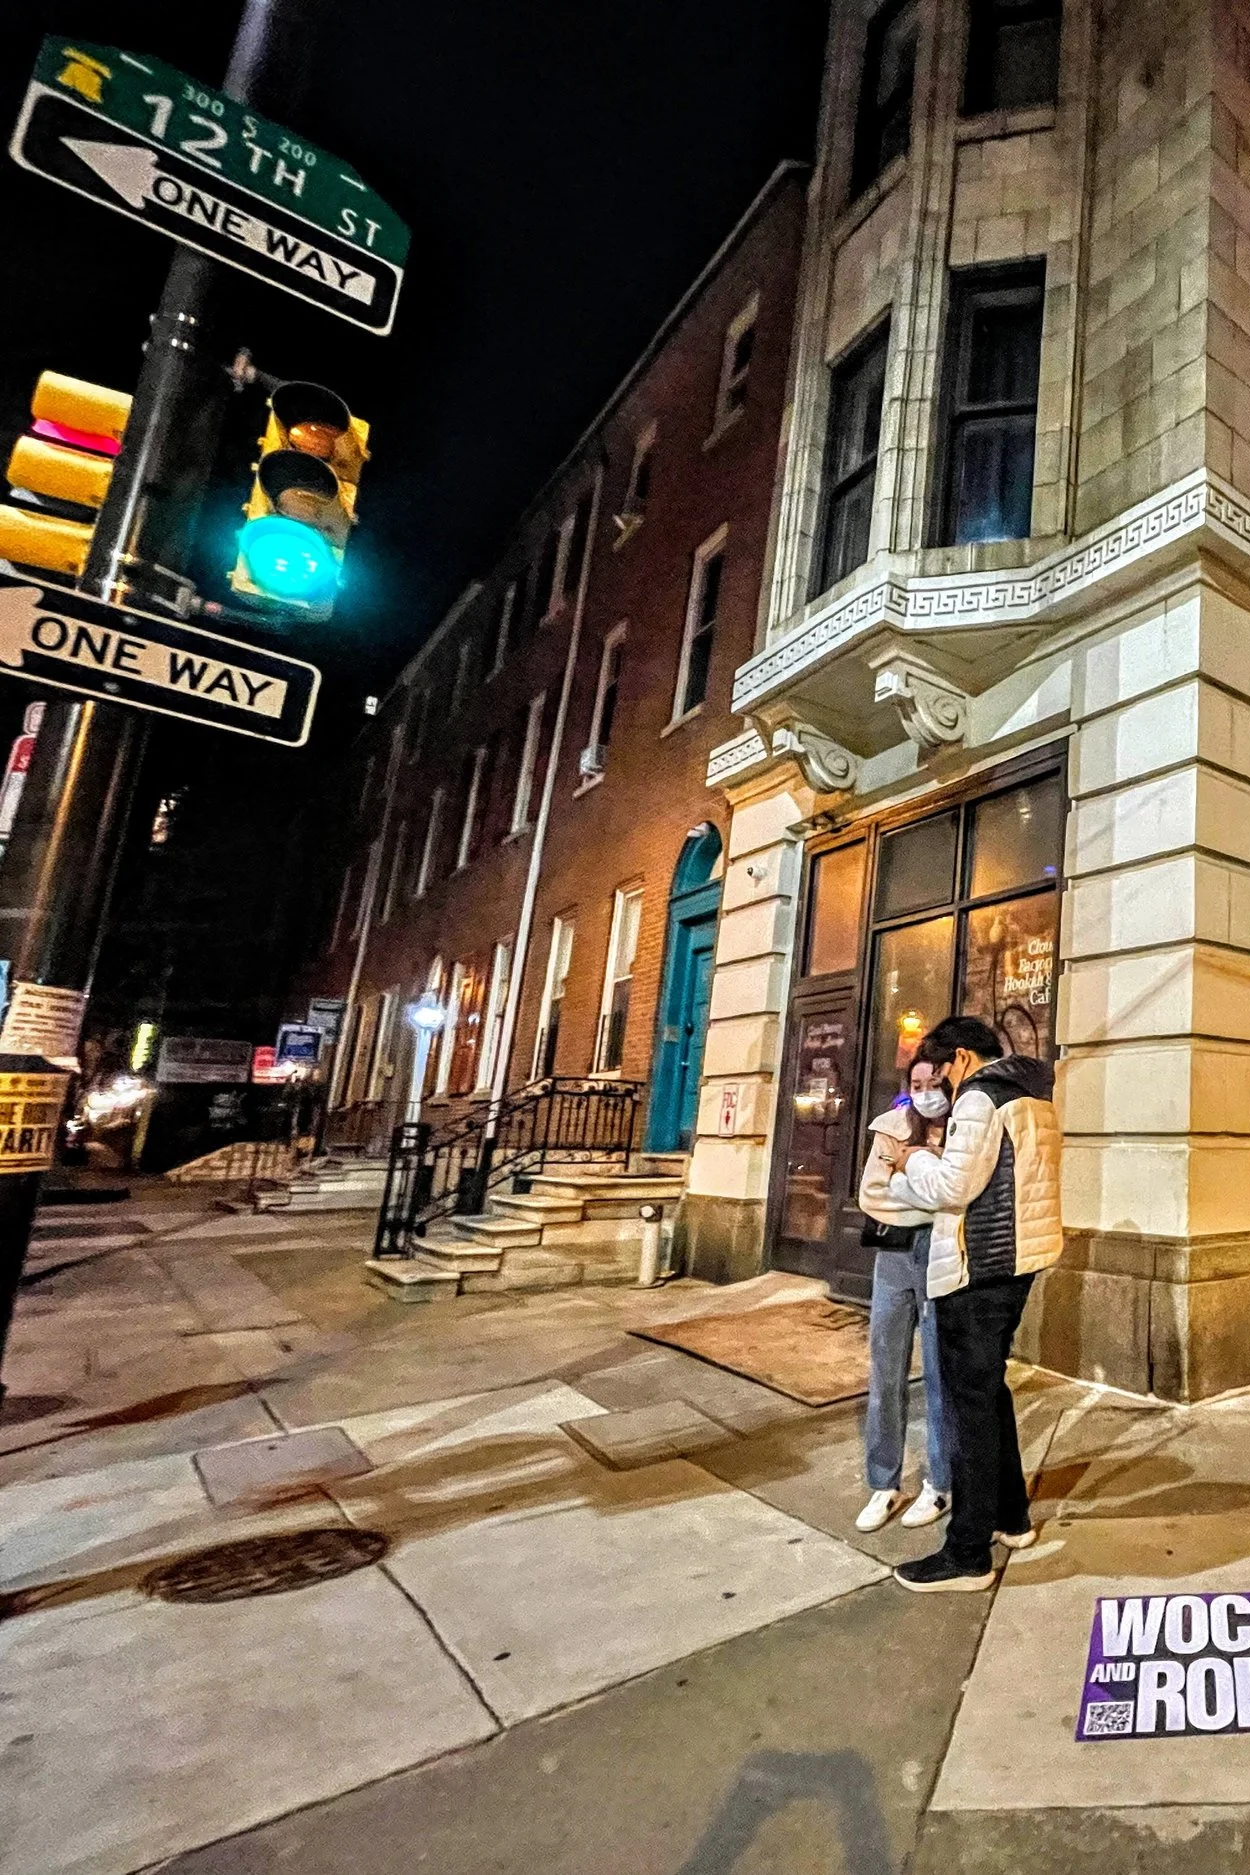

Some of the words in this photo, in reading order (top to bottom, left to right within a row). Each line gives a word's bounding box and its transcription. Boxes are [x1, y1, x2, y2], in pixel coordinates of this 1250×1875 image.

[182, 83, 225, 117] 300
[242, 115, 258, 138] S
[278, 137, 317, 166] 200
[143, 94, 306, 197] 12TH
[337, 208, 382, 247] ST
[153, 176, 252, 242] ONE
[265, 228, 361, 290] WAY
[31, 617, 147, 675] ONE
[168, 652, 272, 706] WAY
[1030, 986, 1051, 1005] Caf
[1090, 1662, 1135, 1683] AND
